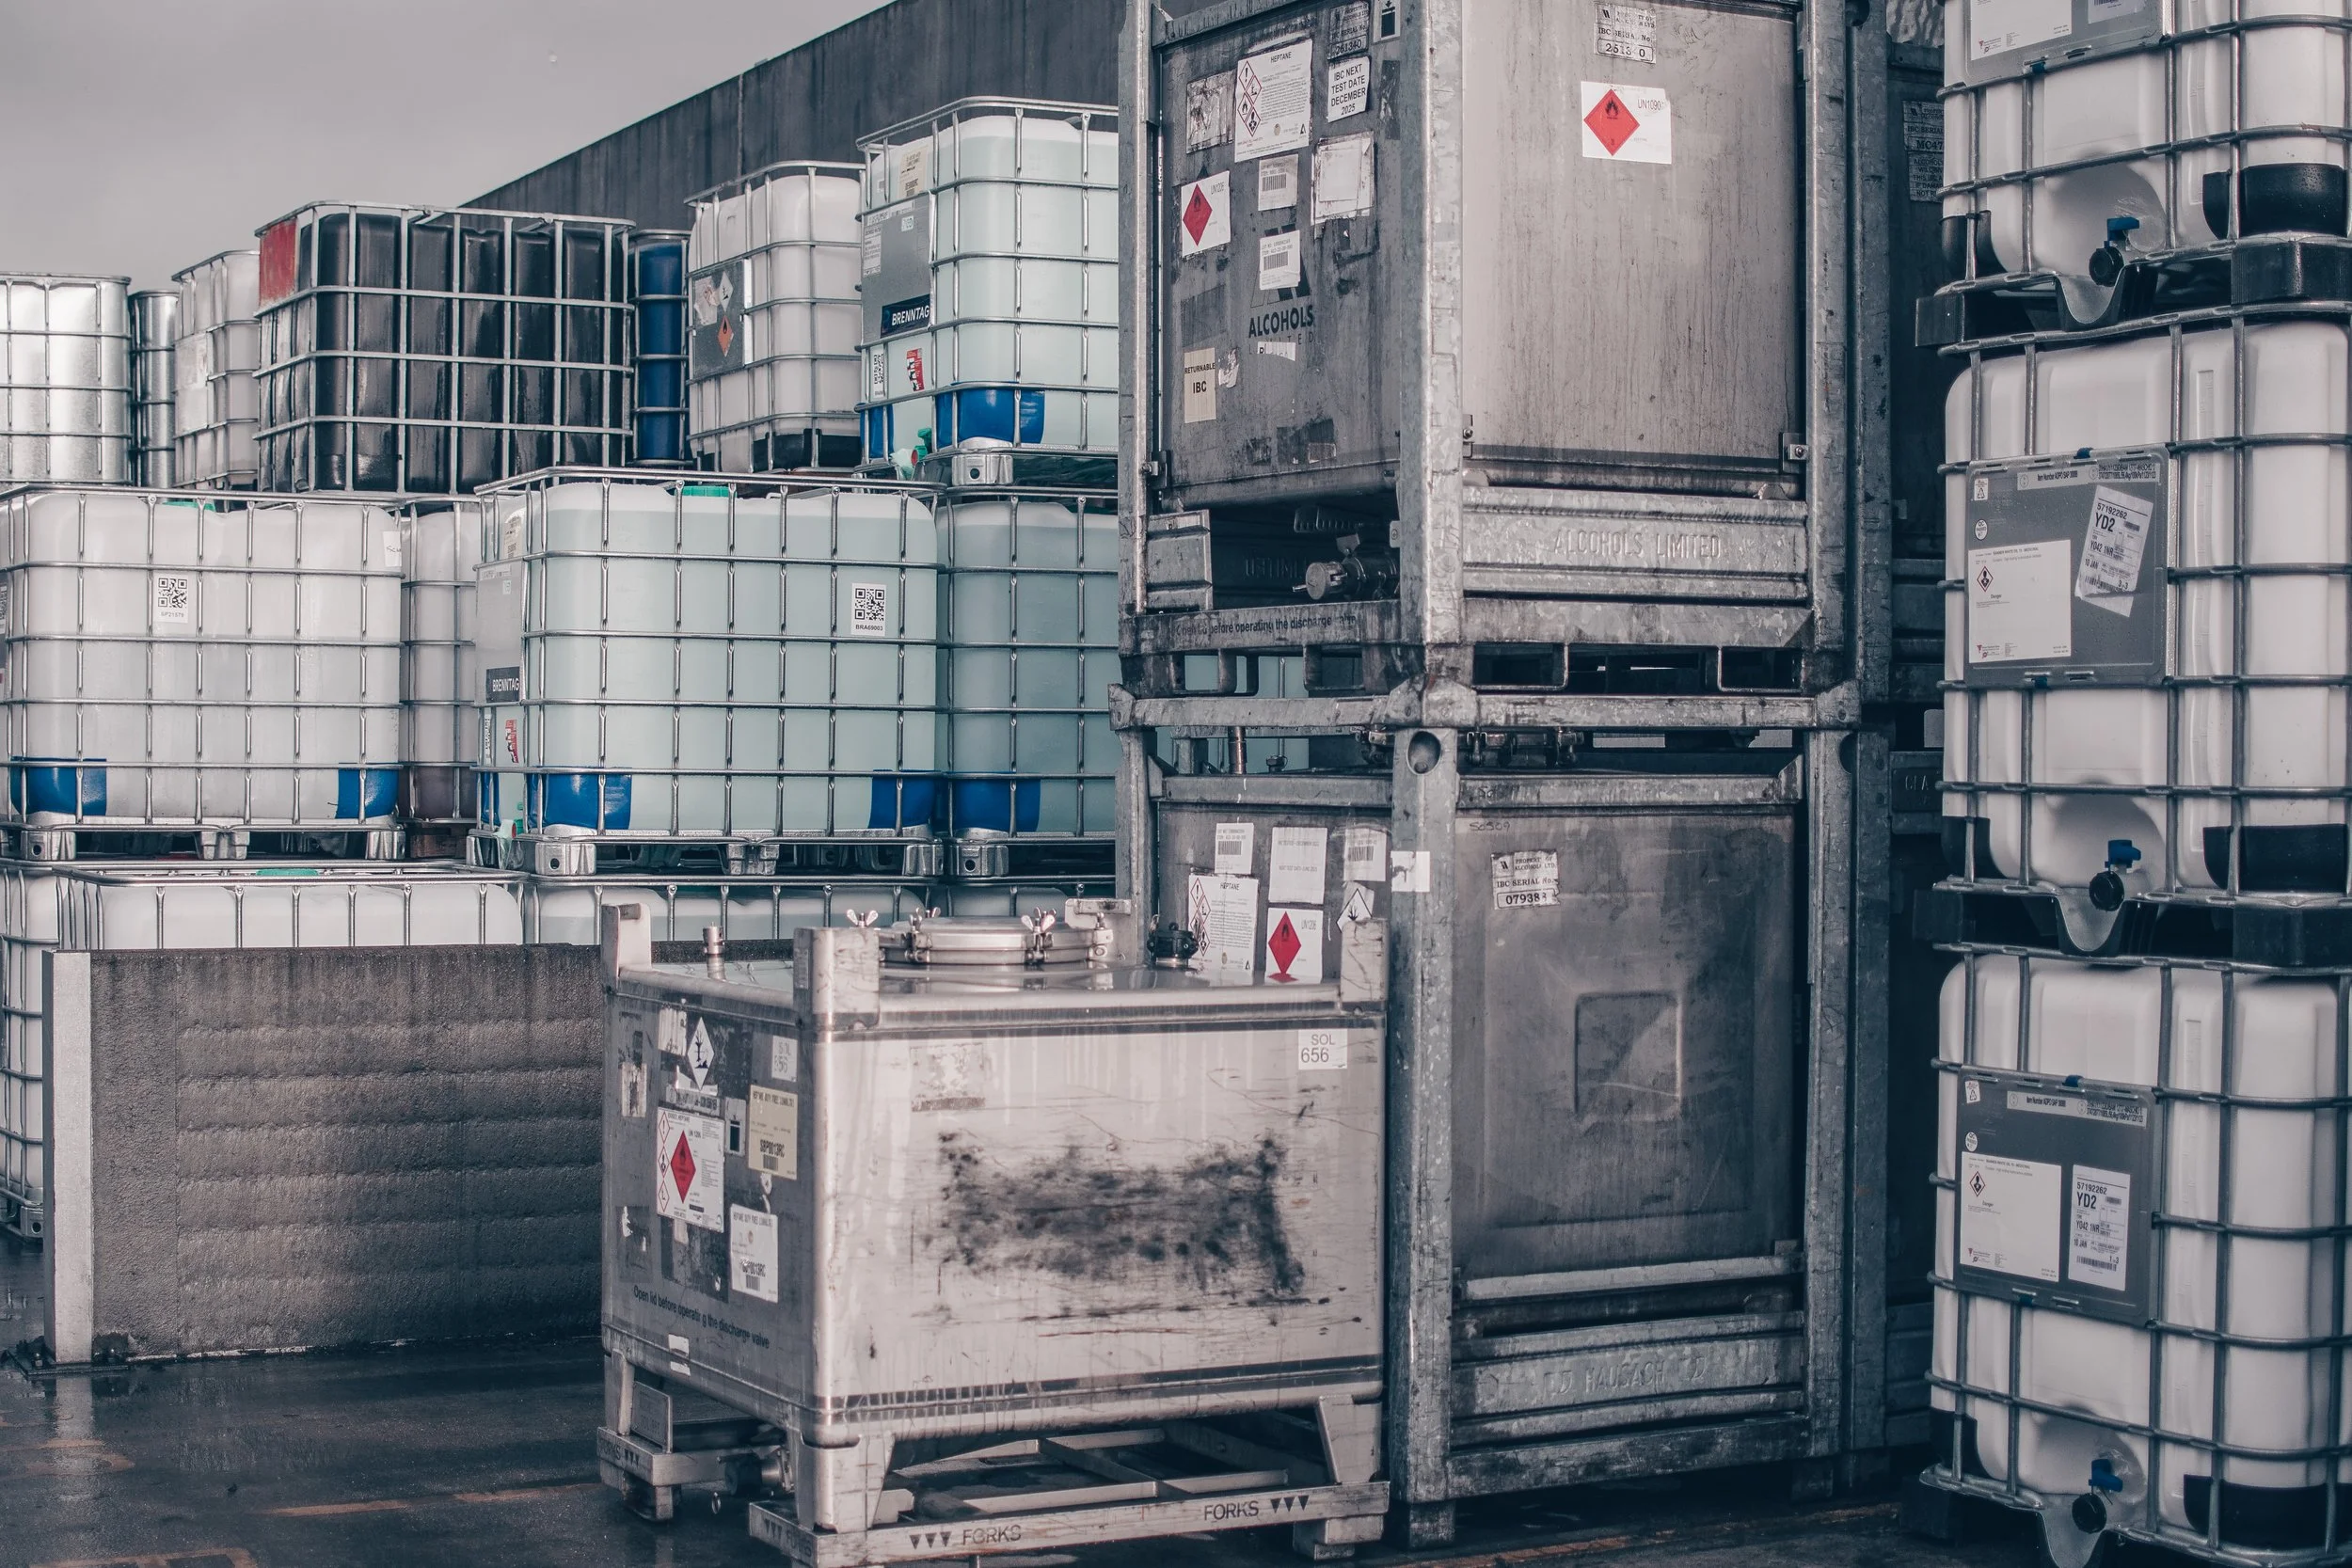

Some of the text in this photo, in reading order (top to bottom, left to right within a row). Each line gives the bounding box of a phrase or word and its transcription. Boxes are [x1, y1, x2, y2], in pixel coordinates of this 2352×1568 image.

[1598, 27, 1612, 36] IBC
[1270, 52, 1292, 63] HEPTANE
[1334, 64, 1362, 81] IBC NEXT
[1331, 75, 1365, 94] TEST DATE
[1331, 87, 1366, 106] DECEMBER
[1341, 103, 1356, 115] 2025
[892, 305, 930, 326] BRENNTAG
[1248, 304, 1314, 339] ALCOHOLS
[1184, 363, 1216, 374] RETURNABLE
[1193, 381, 1207, 394] IBC
[2097, 502, 2128, 520] 57192262
[2095, 513, 2116, 532] YD2
[1554, 530, 1723, 560] ALCOHOLS LIMITED
[1235, 619, 1274, 634] operating
[1276, 618, 1288, 630] the
[1290, 615, 1332, 629] discharge
[493, 677, 519, 692] BRENNTAG
[1220, 882, 1240, 891] HEPTANE
[1512, 879, 1540, 887] SERIAL
[1311, 1033, 1336, 1046] SOL
[1301, 1047, 1329, 1063] 656
[2077, 1181, 2107, 1196] 57192262
[2076, 1192, 2097, 1210] YD2
[633, 1285, 649, 1302] Open
[658, 1293, 676, 1313] before
[707, 1313, 718, 1329] the
[719, 1317, 751, 1343] discharge
[751, 1333, 770, 1349] valve
[1203, 1501, 1260, 1521] FORKS
[963, 1524, 1022, 1545] FORKS
